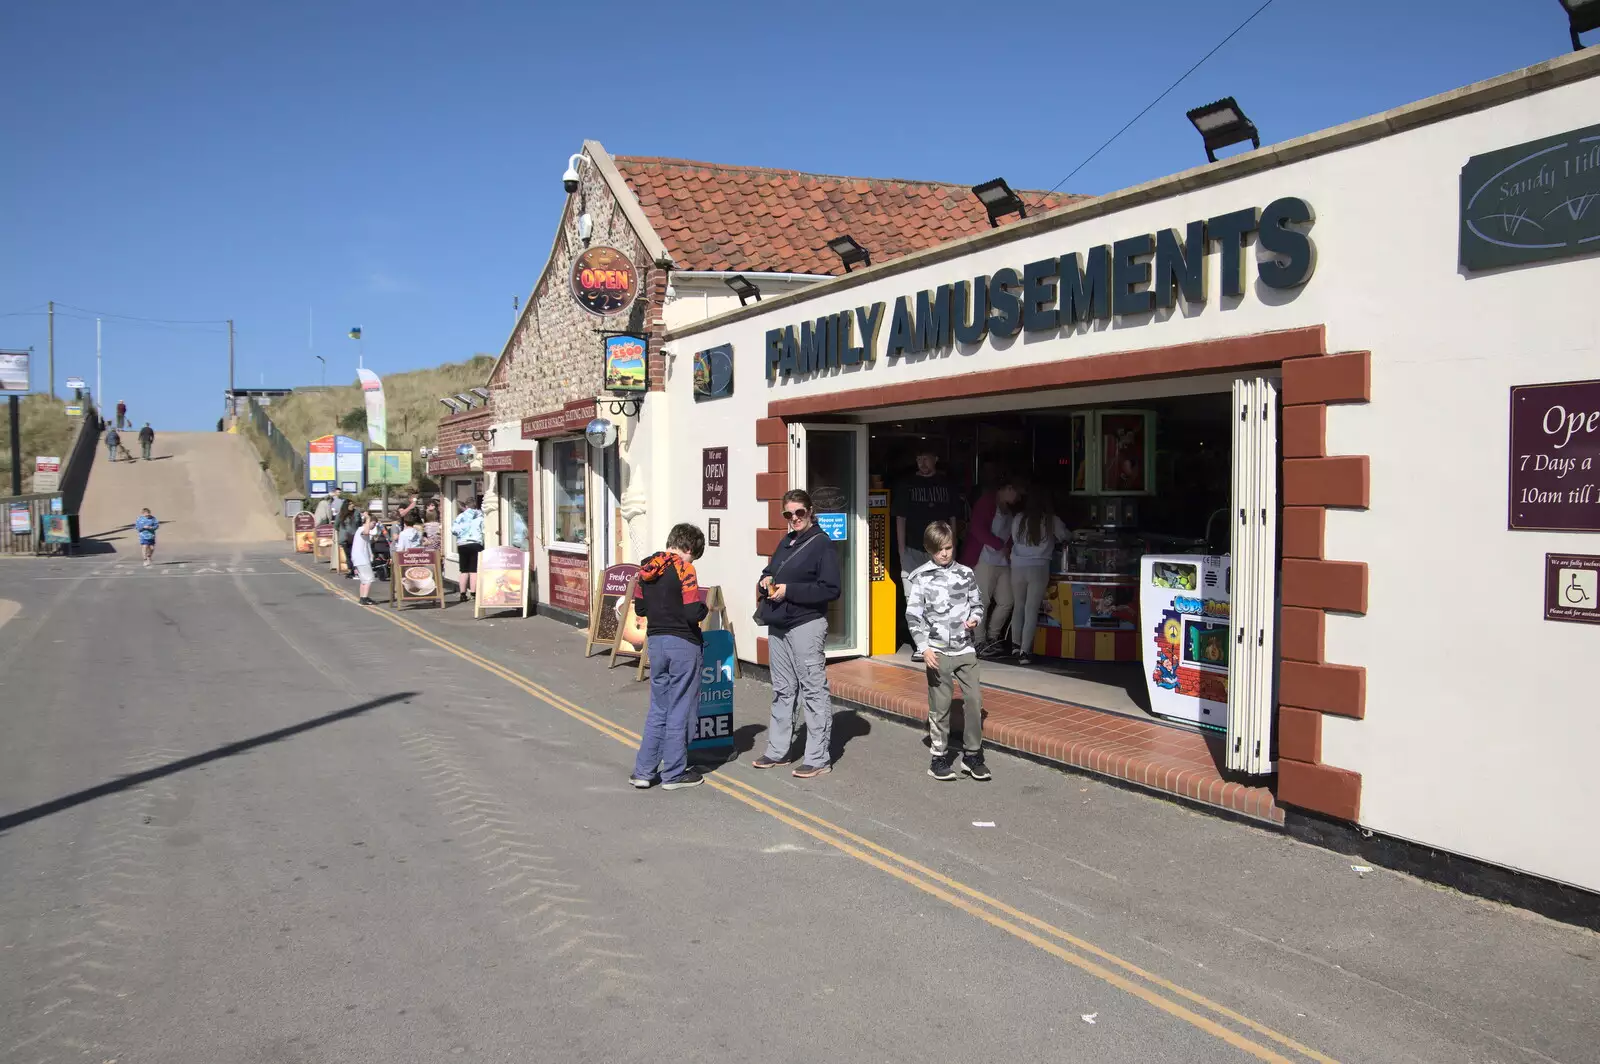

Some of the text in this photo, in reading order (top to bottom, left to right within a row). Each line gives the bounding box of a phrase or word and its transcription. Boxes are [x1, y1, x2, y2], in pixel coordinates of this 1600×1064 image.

[1499, 163, 1555, 201] Sandy
[581, 268, 629, 290] OPEN
[765, 196, 1316, 382] FAMILY AMUSEMENTS
[613, 345, 643, 360] £500
[708, 450, 716, 460] We
[705, 463, 725, 478] OPEN
[1520, 454, 1593, 479] 7 Days a
[714, 481, 724, 496] days
[1520, 487, 1562, 504] 10am
[1568, 484, 1595, 504] till
[711, 497, 721, 506] Year
[609, 570, 625, 582] Fresh
[606, 583, 627, 592] Served
[1572, 609, 1581, 617] for
[701, 659, 732, 684] sh
[699, 688, 731, 702] hine
